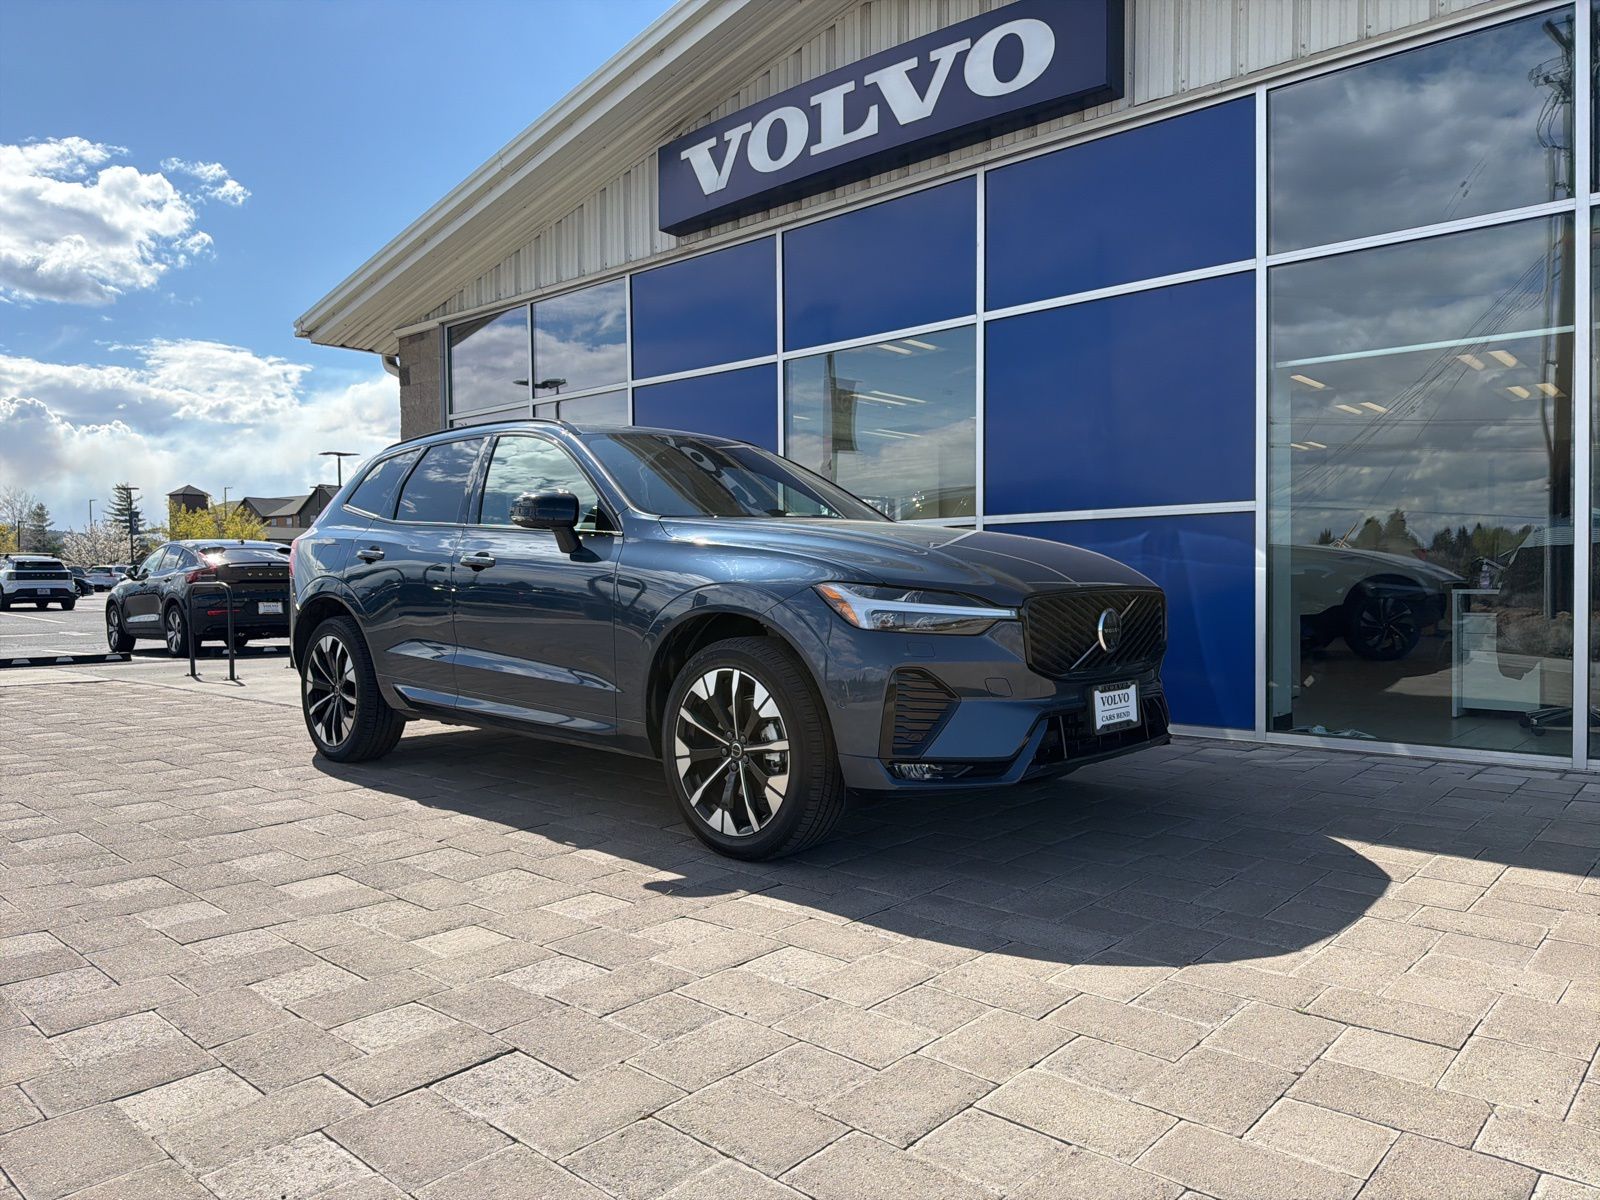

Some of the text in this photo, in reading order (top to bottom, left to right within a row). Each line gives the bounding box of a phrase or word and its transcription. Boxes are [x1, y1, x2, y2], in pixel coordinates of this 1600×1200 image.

[681, 18, 1056, 196] VOLVO
[1101, 692, 1130, 707] VOLVO
[1101, 711, 1131, 722] CARS BEND
